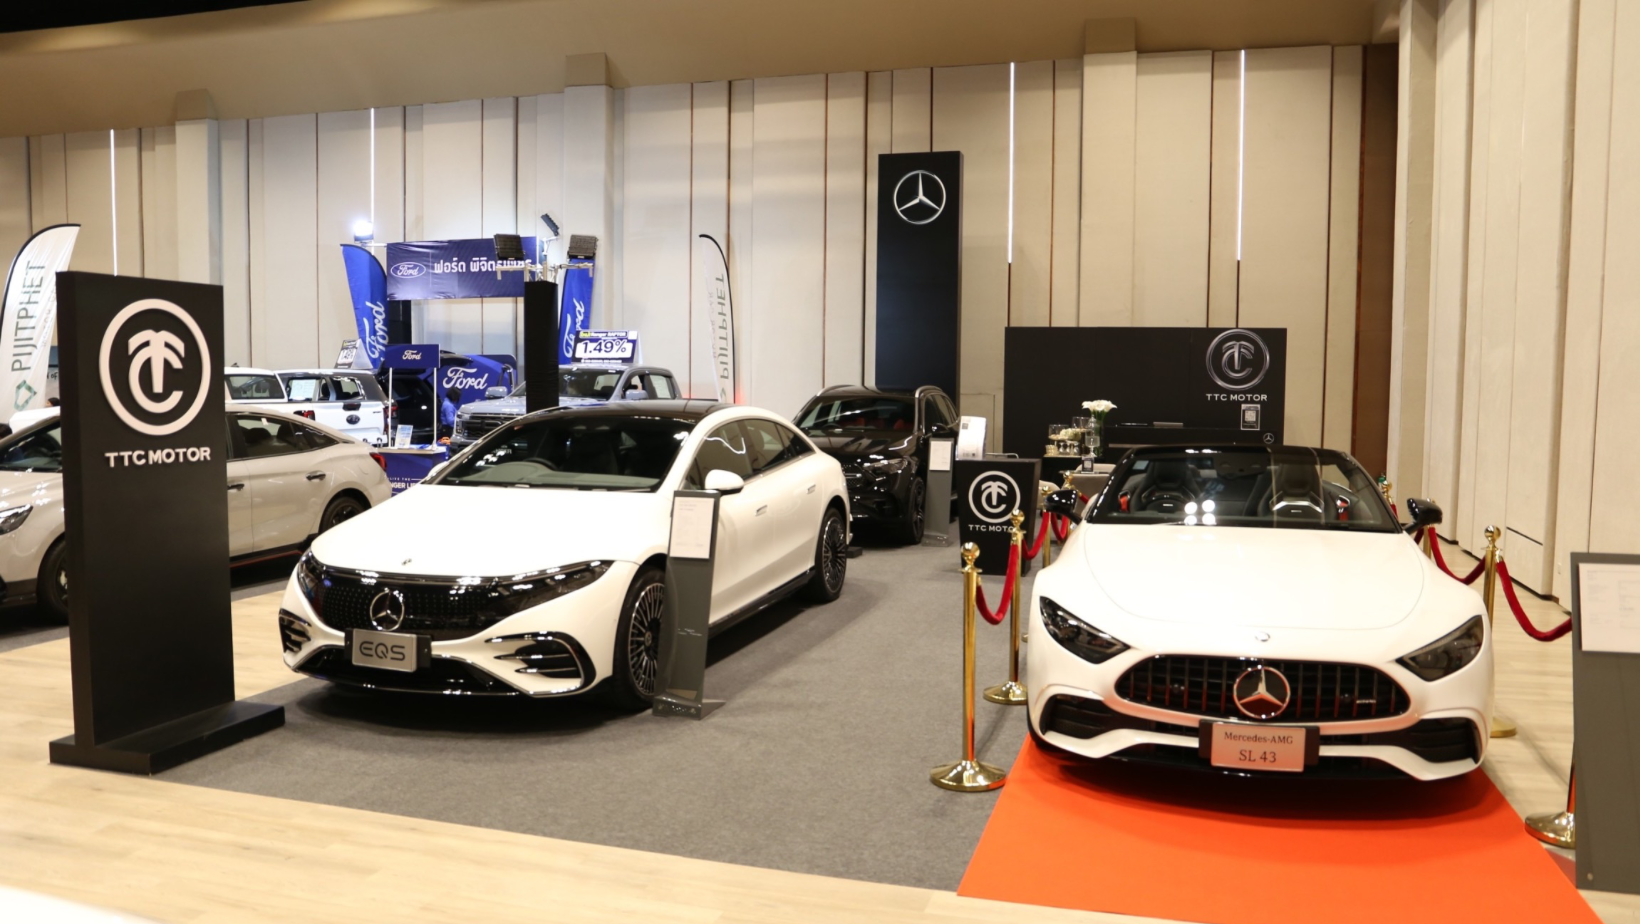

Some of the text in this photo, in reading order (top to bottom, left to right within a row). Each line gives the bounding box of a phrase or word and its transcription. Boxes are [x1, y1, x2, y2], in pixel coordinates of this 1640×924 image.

[397, 264, 419, 276] Ford
[434, 257, 466, 273] ฟอร์ด
[11, 260, 46, 372] PIJITPHET
[363, 301, 388, 360] Ford
[582, 340, 627, 354] 1.49%
[402, 349, 422, 360] Ford
[442, 366, 489, 390] Ford
[1206, 393, 1268, 402] TTC MOTOR
[104, 446, 211, 468] TTC MOTOR
[968, 524, 1014, 533] TTC MOTO
[359, 641, 406, 661] EQS
[1224, 731, 1294, 745] Mercedes-AMG
[1239, 749, 1277, 763] SL 43
